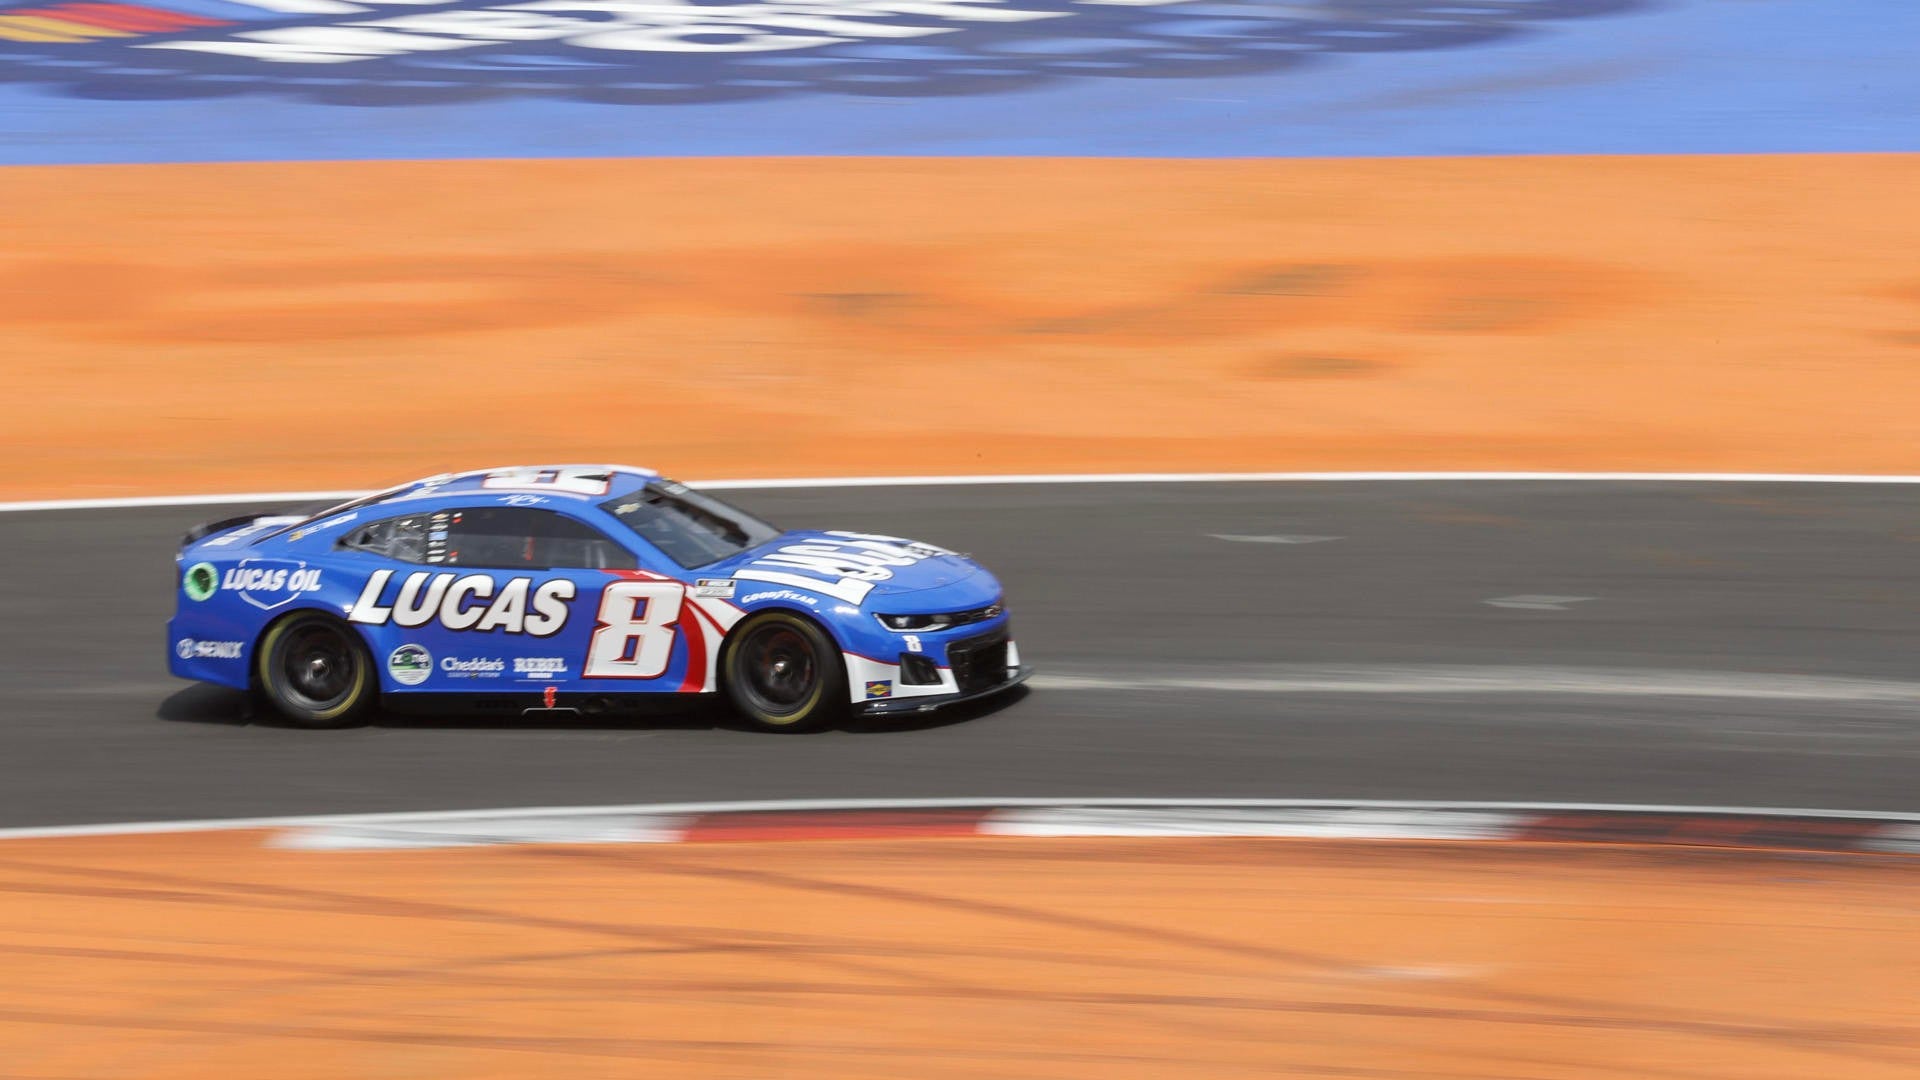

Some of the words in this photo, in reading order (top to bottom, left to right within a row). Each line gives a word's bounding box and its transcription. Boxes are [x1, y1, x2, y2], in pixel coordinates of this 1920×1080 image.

[221, 567, 288, 591] LUCAS
[287, 569, 322, 592] OIL
[730, 530, 958, 606] LUC
[347, 568, 578, 637] LUCAS
[741, 589, 818, 605] GOODYEAR
[582, 579, 686, 679] 8
[902, 635, 923, 652] 8
